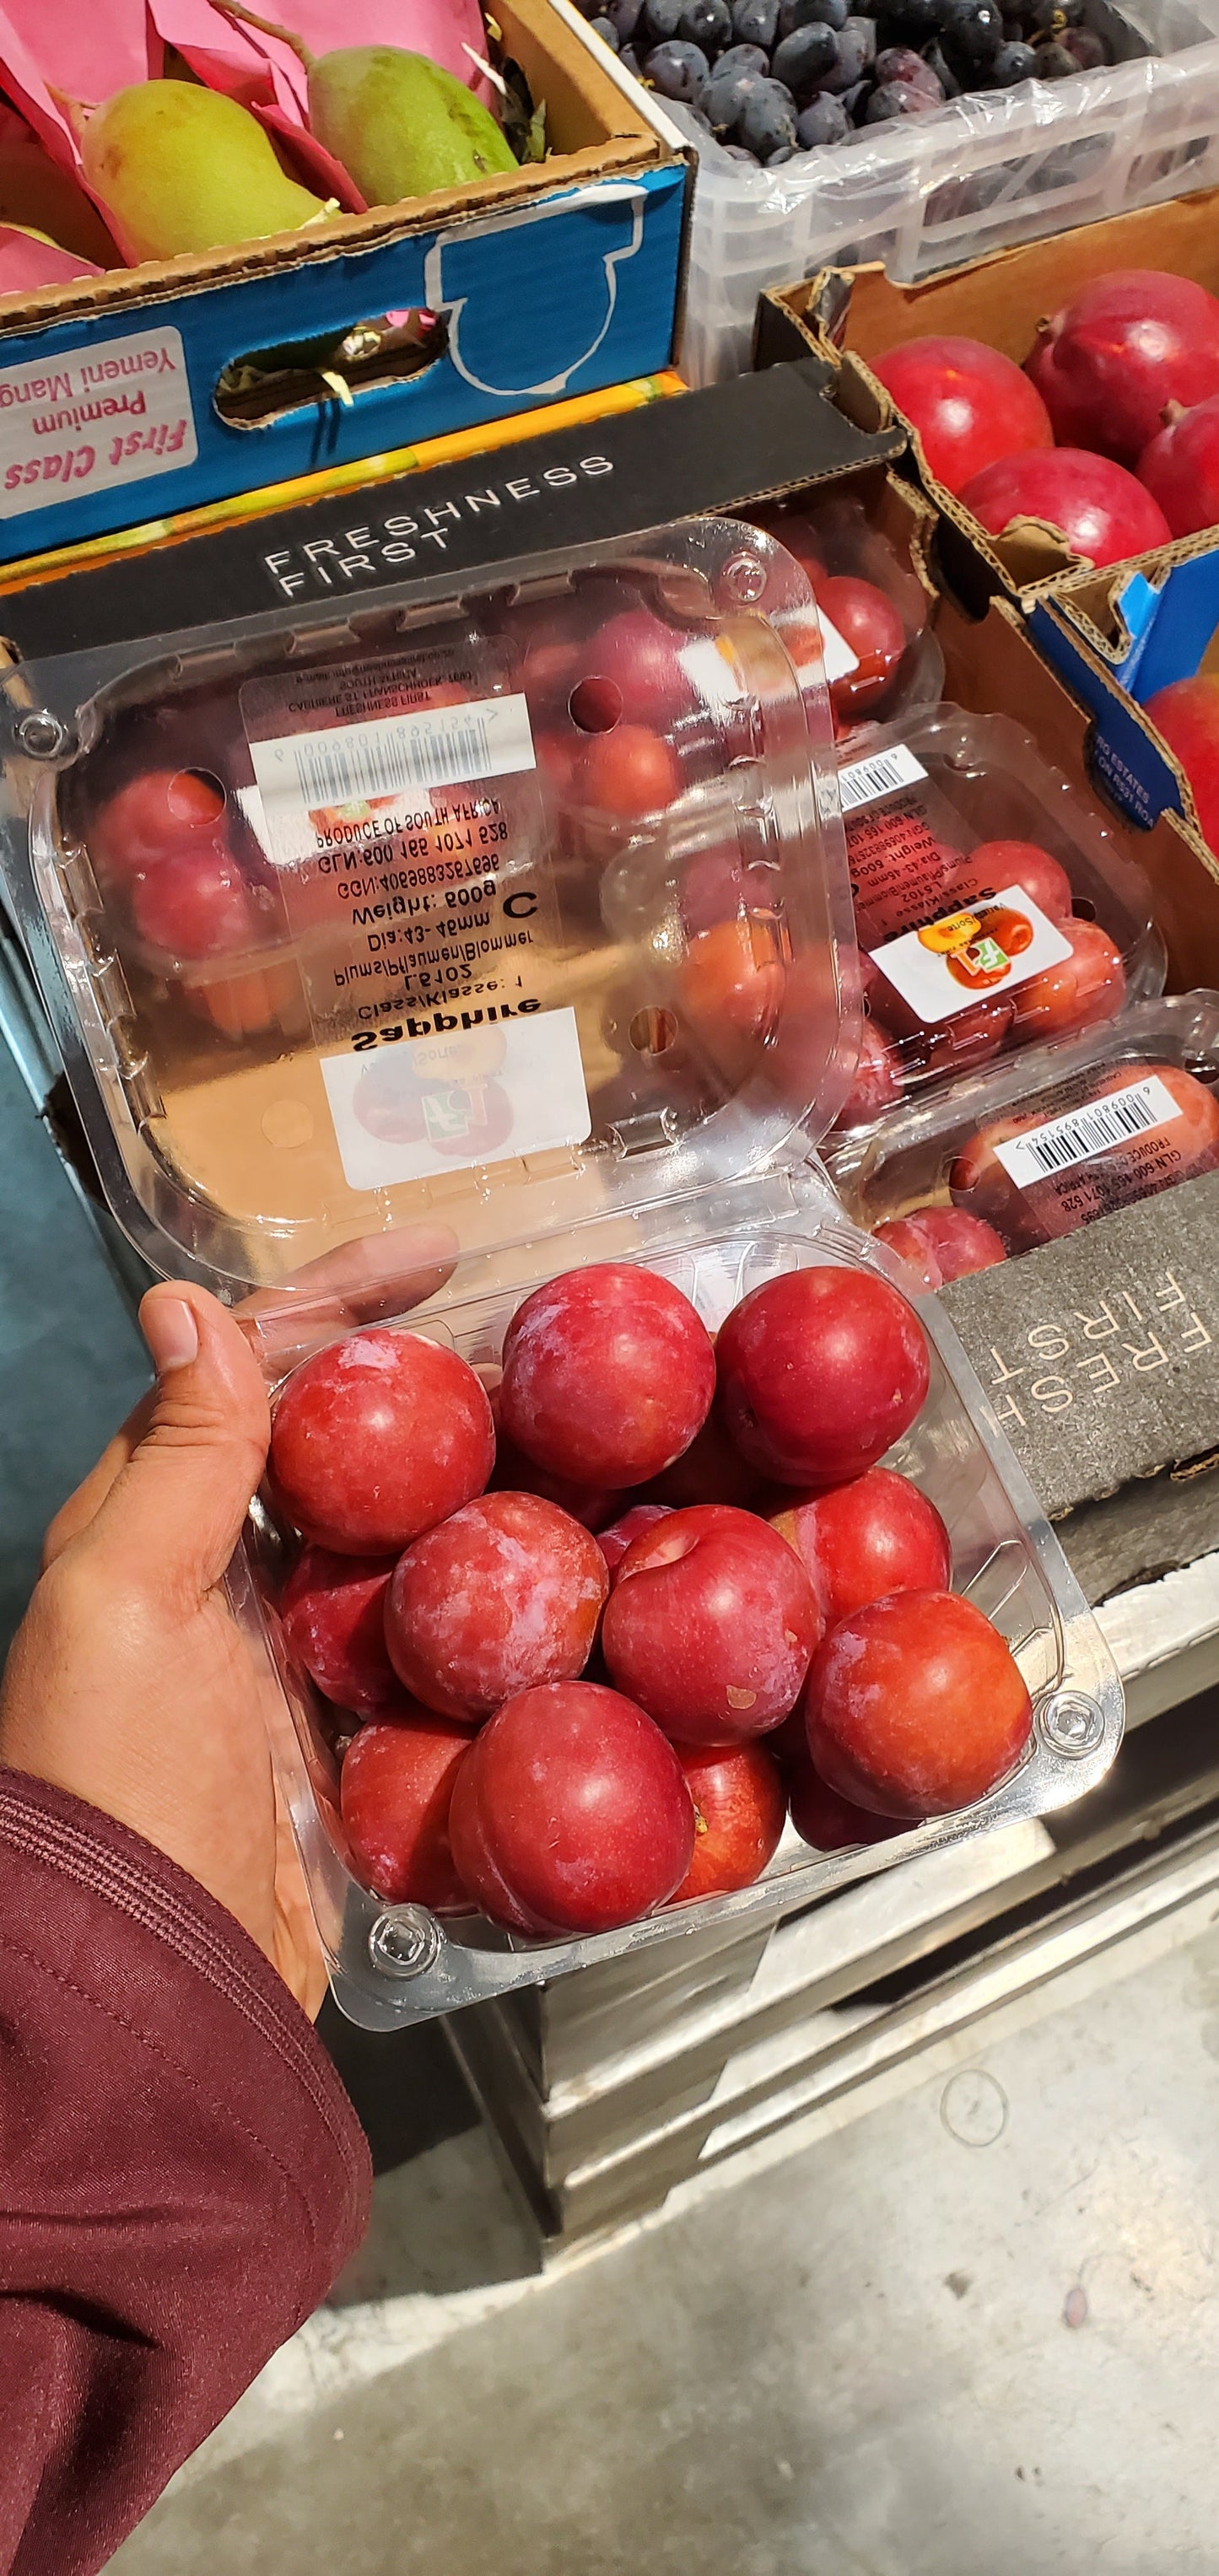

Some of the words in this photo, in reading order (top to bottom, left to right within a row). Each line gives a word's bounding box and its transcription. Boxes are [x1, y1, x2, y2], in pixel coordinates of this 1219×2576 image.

[80, 347, 176, 393] Yemeni
[32, 390, 146, 435] Premium
[109, 419, 187, 466] First
[4, 445, 96, 490] Class
[263, 455, 614, 575] FRESHNESS
[278, 528, 449, 597] FIRST
[1111, 752, 1150, 804] ESTATES
[887, 836, 936, 864] Weight:
[883, 887, 997, 943] Sapphire
[1087, 1093, 1135, 1122] 009801
[1143, 1086, 1151, 1097] 6
[1031, 1118, 1080, 1146] 895154
[990, 1271, 1186, 1385] FIRST
